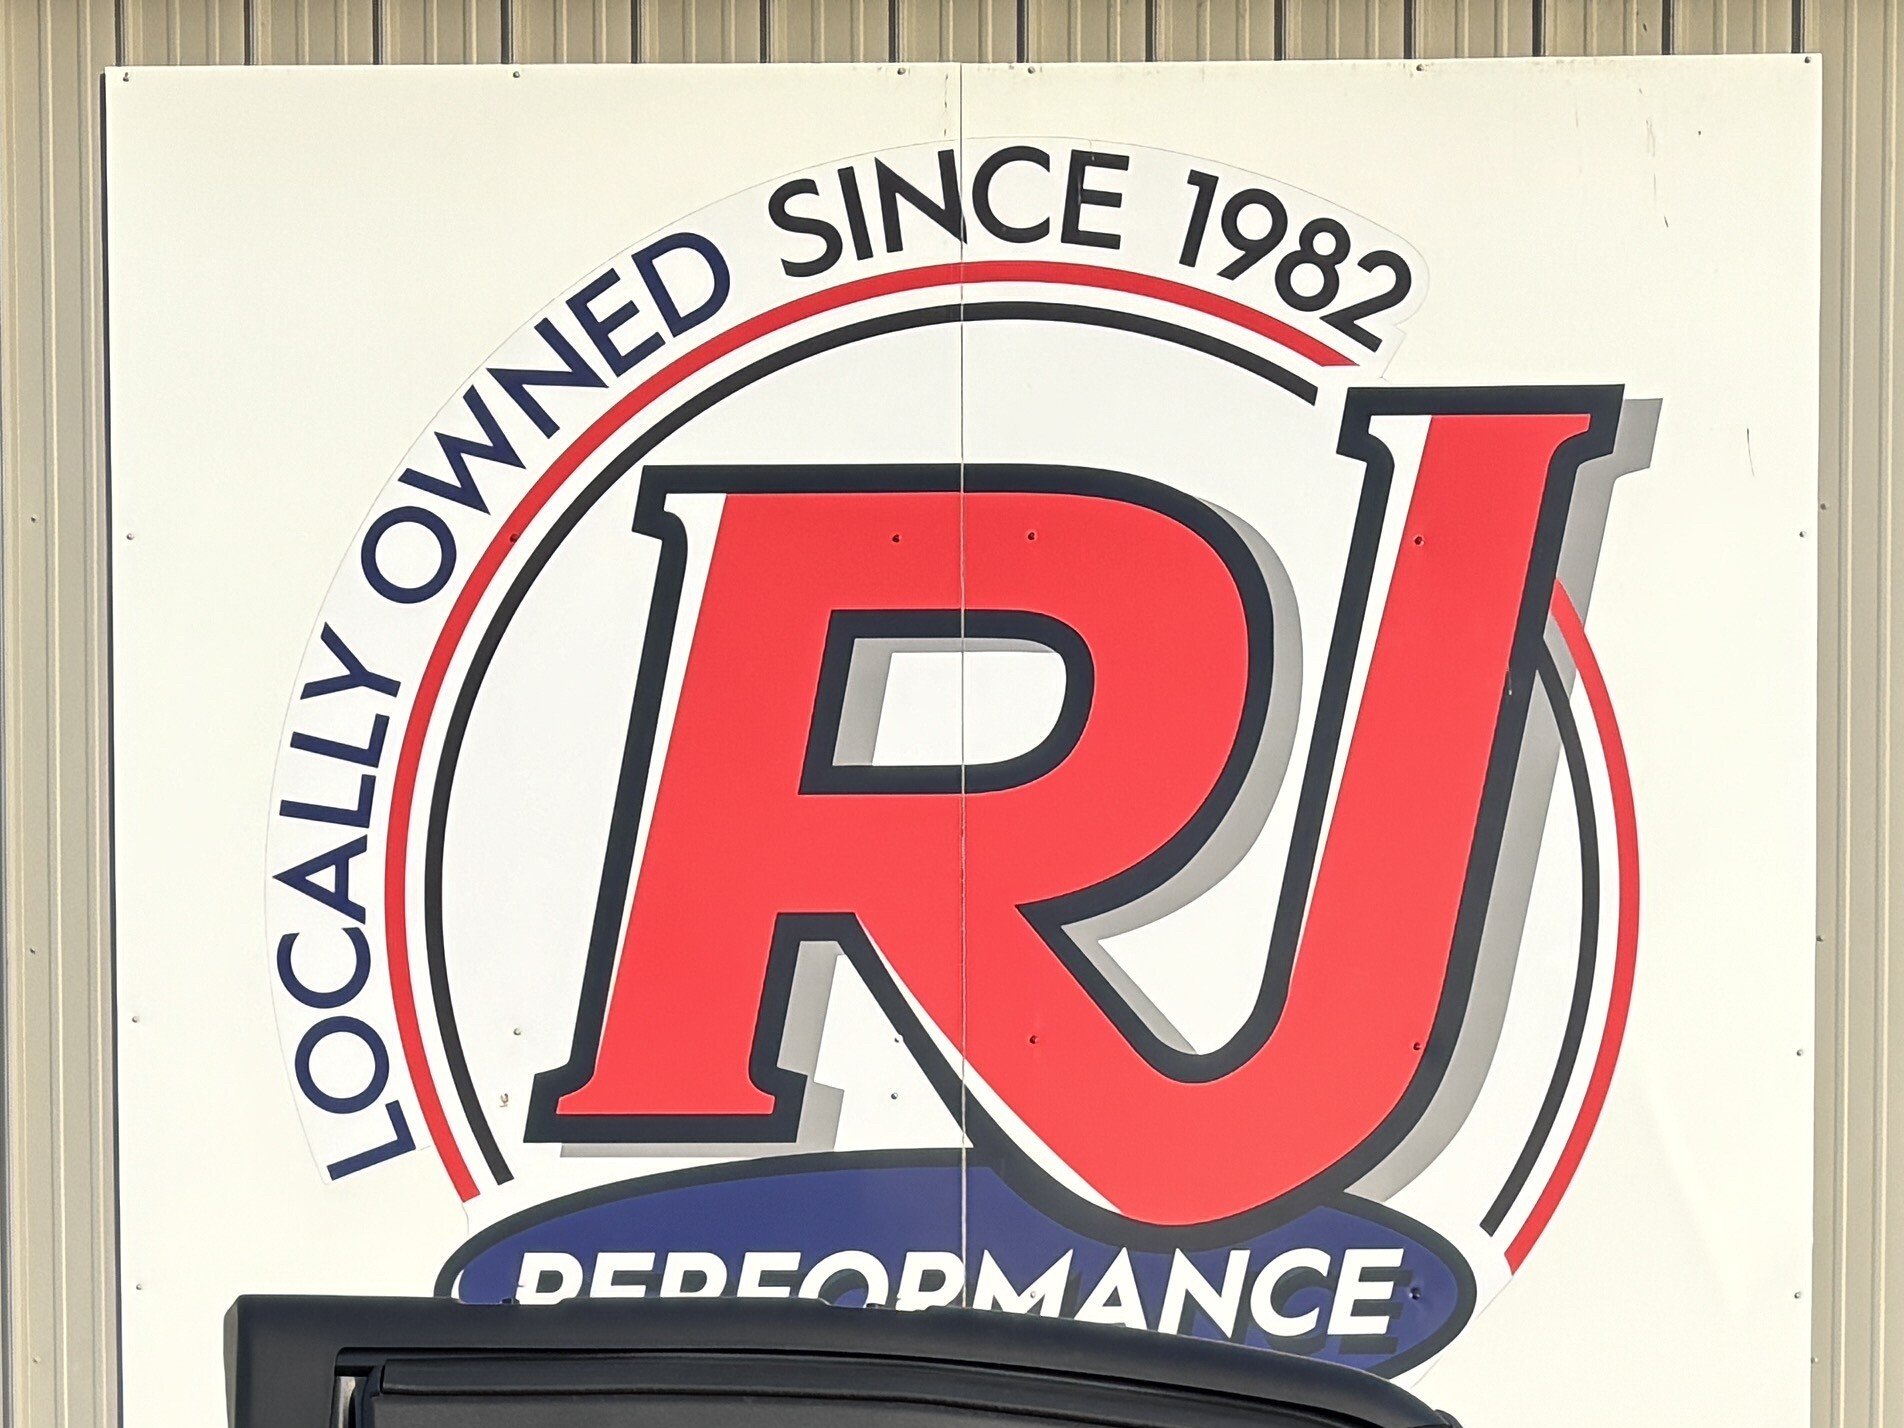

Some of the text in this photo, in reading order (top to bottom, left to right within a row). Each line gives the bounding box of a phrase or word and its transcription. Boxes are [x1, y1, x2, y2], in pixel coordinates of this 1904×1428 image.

[271, 145, 1412, 1182] LOCALLY OWNED SINCE 1982
[523, 383, 1625, 1246] RJ
